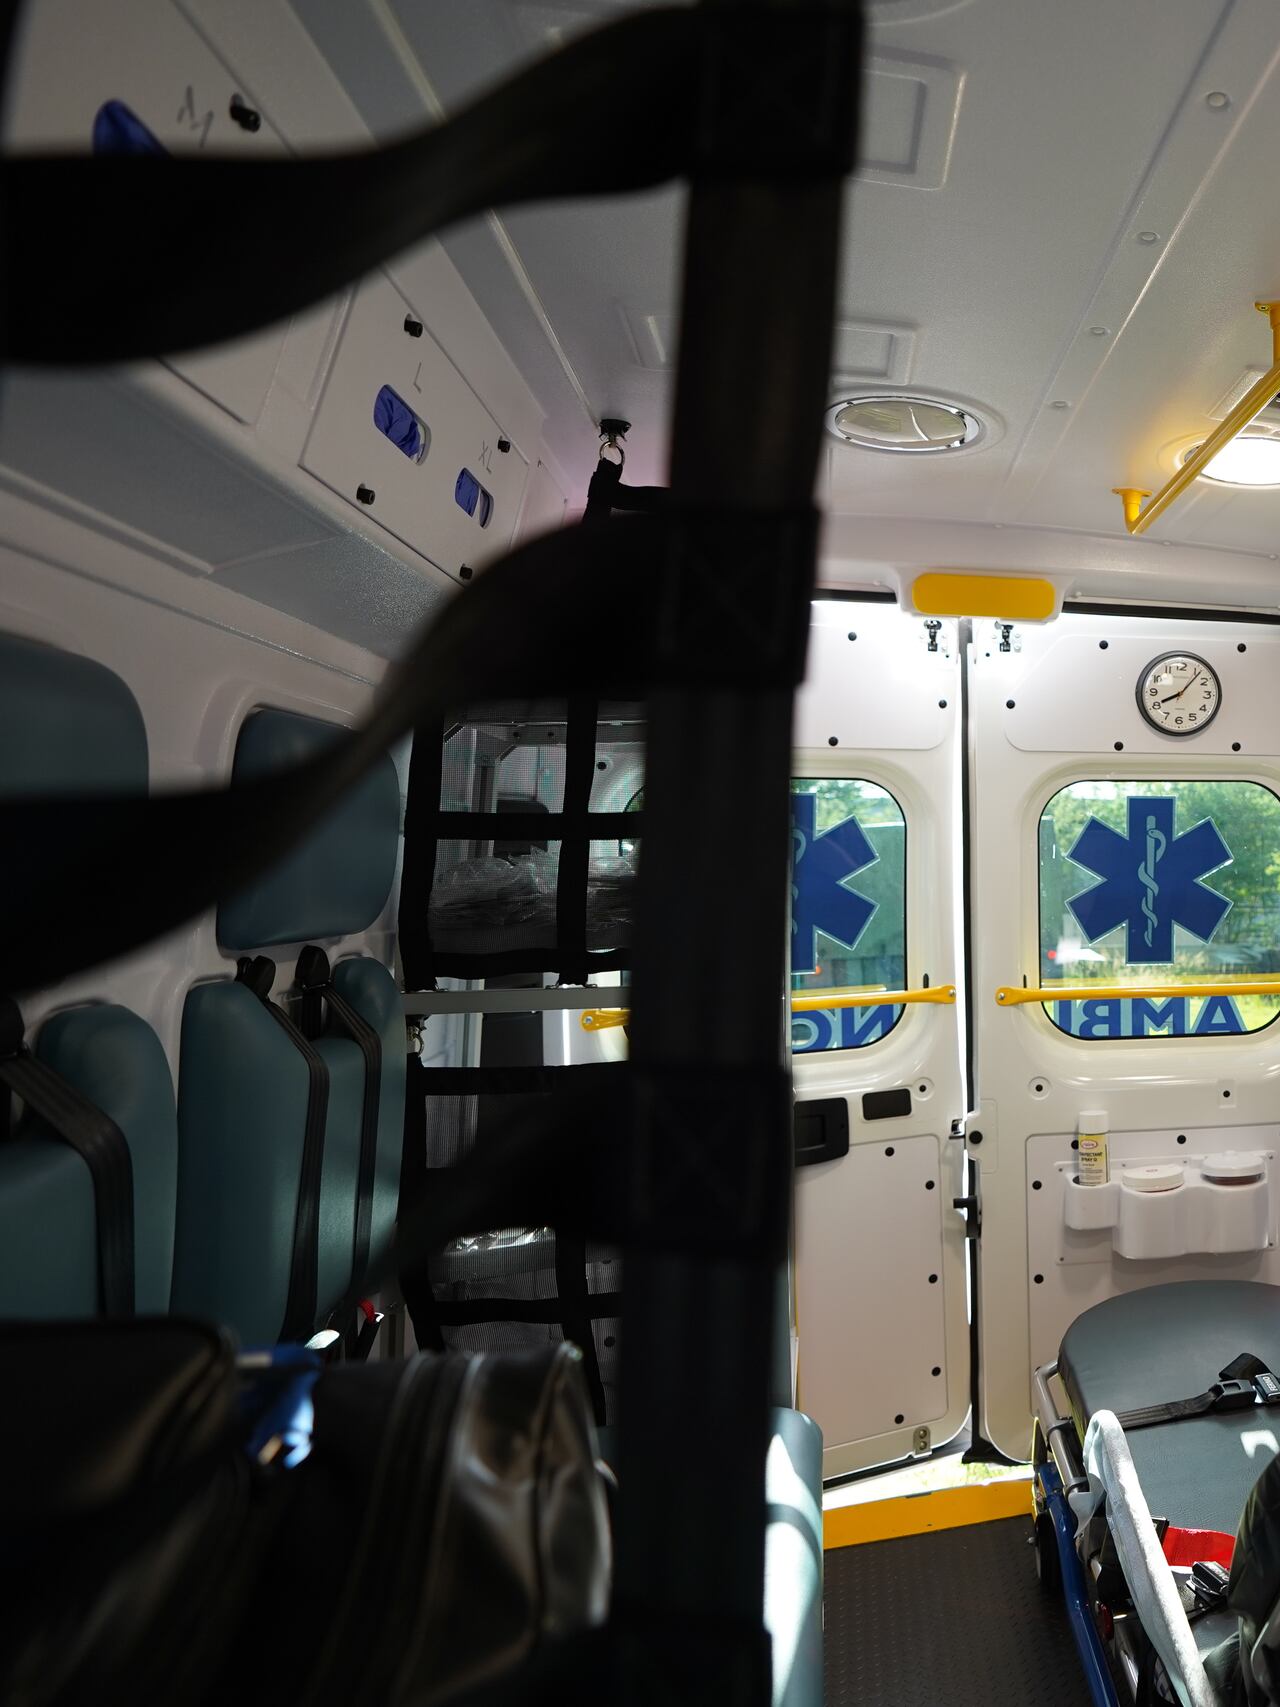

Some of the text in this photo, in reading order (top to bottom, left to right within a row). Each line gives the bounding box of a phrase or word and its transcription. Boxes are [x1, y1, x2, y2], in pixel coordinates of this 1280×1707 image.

[1200, 677, 1209, 686] 2
[1149, 687, 1158, 697] 9
[1203, 690, 1212, 700] 3
[1152, 701, 1161, 710] 8
[1199, 704, 1207, 713] 4
[1162, 711, 1170, 721] 7
[1174, 716, 1184, 725] 6
[1188, 712, 1197, 722] 5
